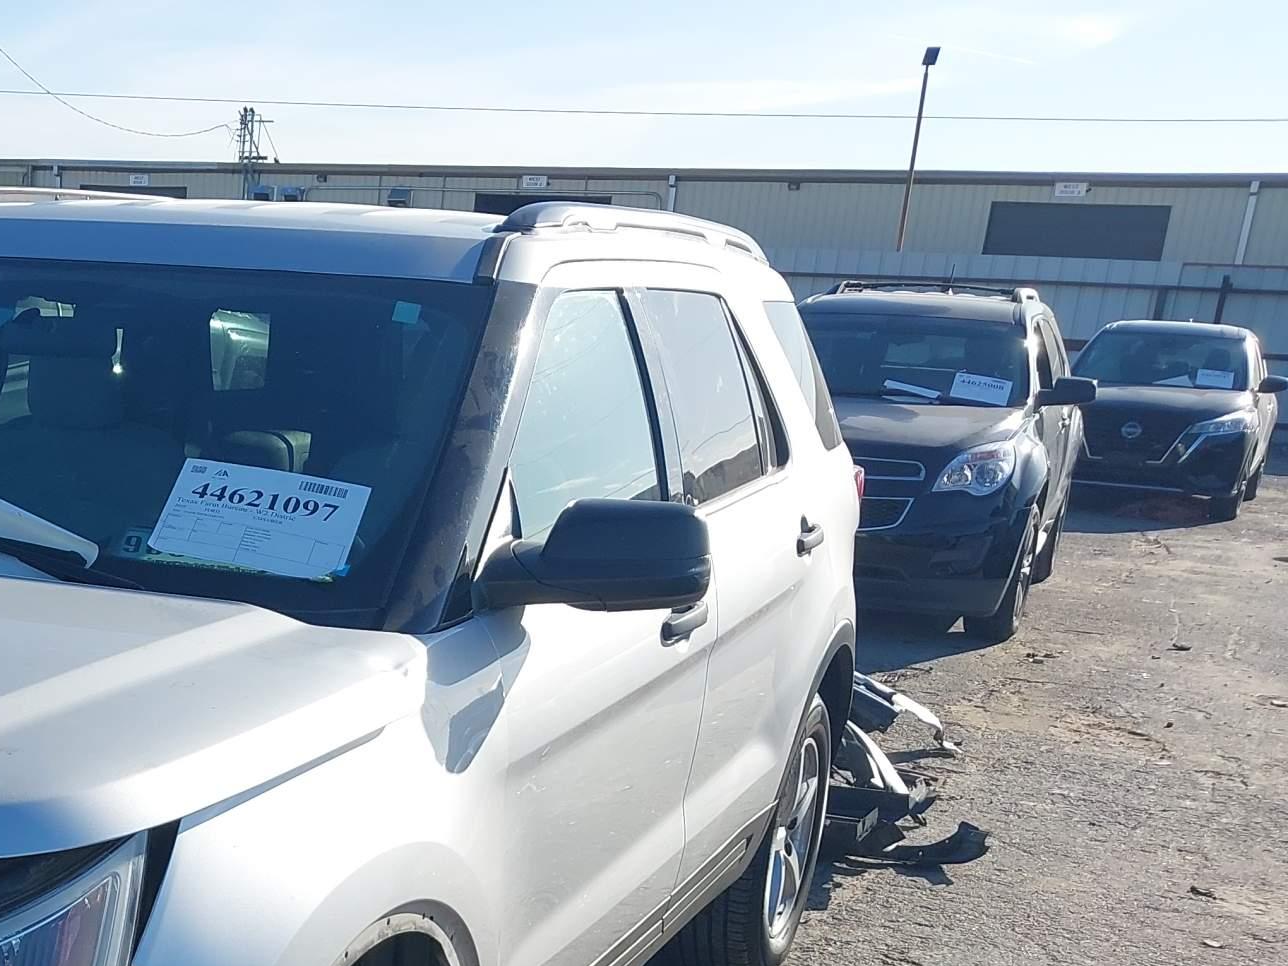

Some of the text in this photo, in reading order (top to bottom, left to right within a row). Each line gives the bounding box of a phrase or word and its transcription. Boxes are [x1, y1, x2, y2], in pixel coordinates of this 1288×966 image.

[177, 496, 198, 505] Texas
[200, 499, 220, 509] Farm
[220, 503, 248, 513] Bureau
[191, 482, 340, 522] 44621097
